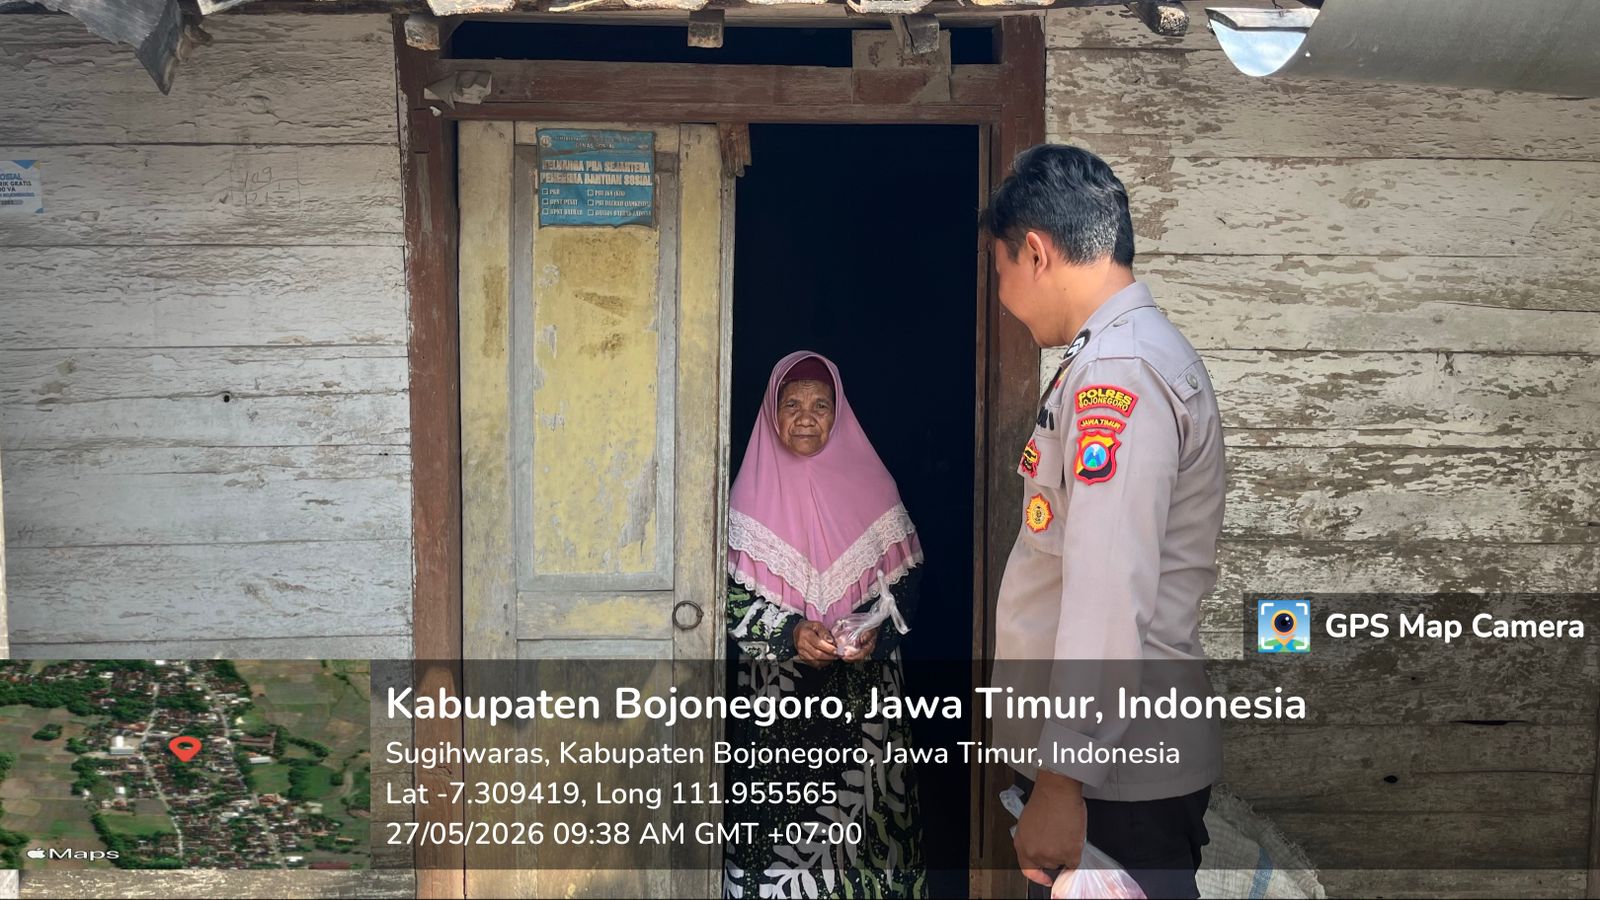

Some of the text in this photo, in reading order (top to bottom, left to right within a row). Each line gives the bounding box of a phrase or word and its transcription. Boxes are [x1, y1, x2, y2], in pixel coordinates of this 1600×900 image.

[584, 173, 622, 185] BANTUAN
[623, 174, 653, 186] SOSIAL
[1079, 388, 1132, 406] POLRES
[1081, 419, 1121, 429] JAWA TIMUR
